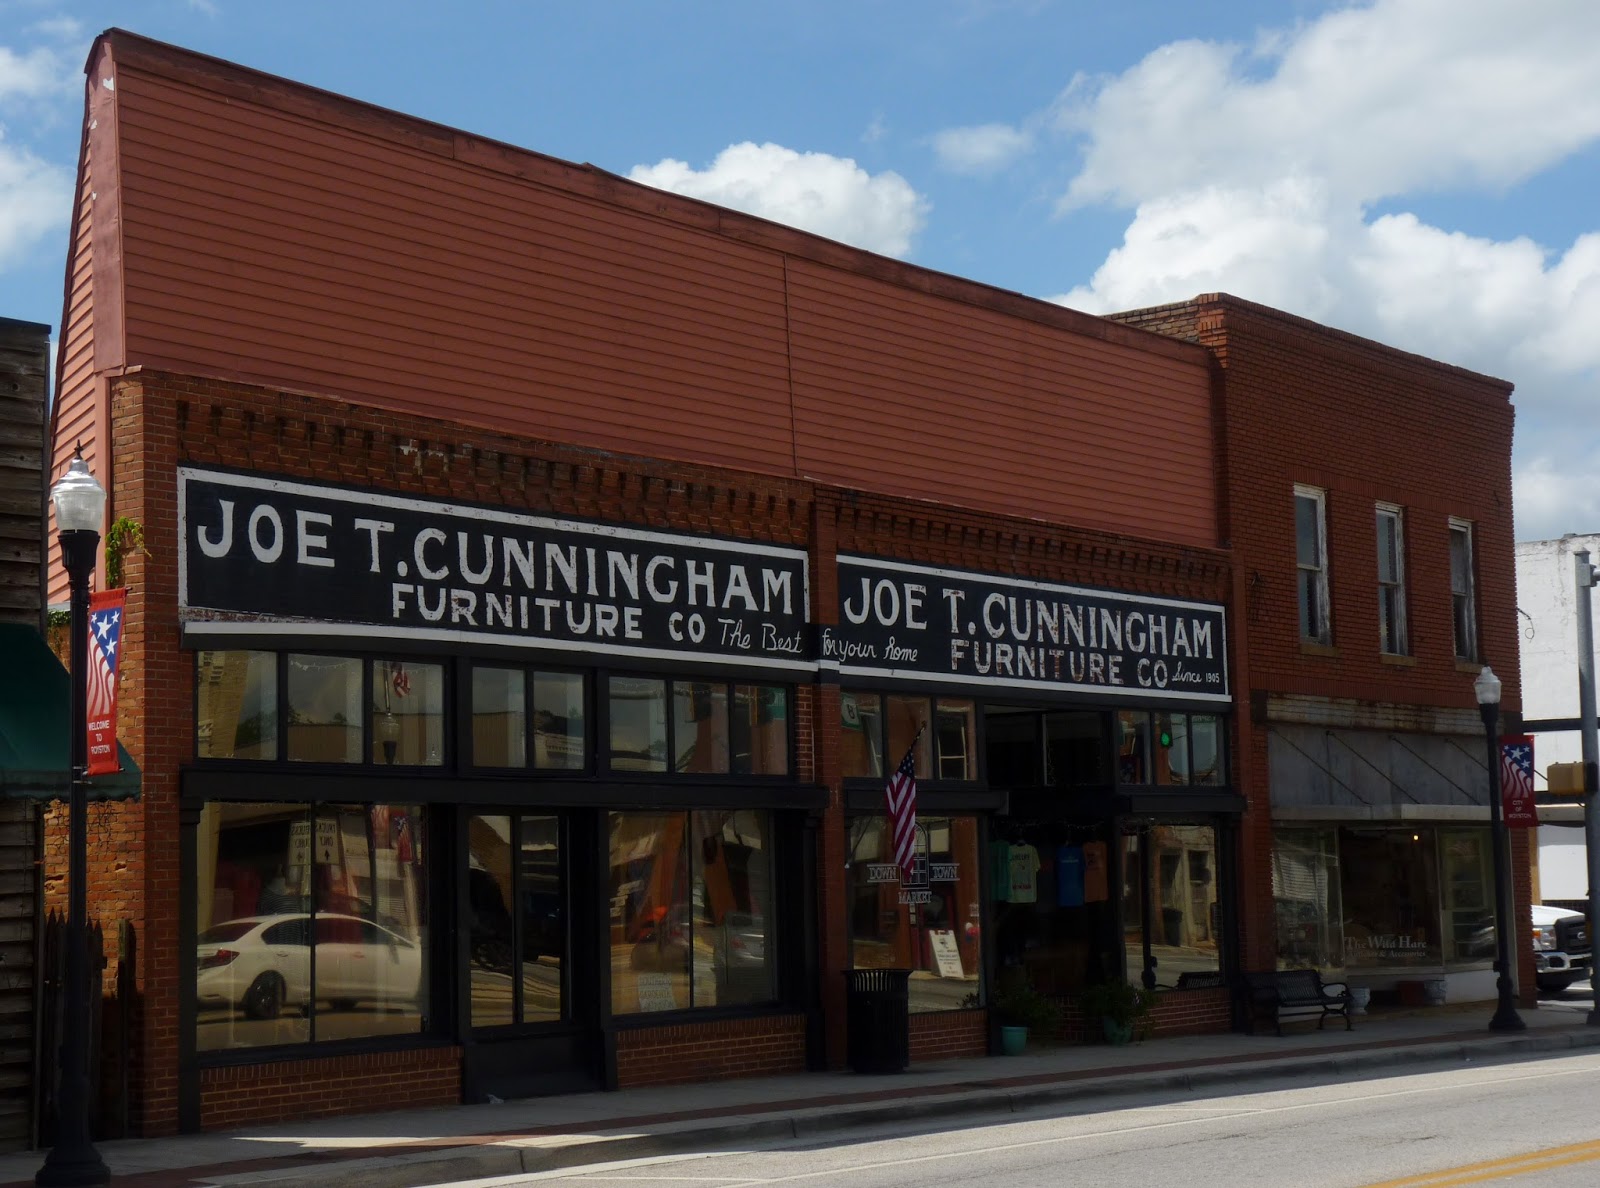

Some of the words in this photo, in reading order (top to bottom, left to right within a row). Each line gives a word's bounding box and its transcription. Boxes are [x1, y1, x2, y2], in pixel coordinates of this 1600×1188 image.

[197, 499, 336, 568] JOE
[843, 577, 927, 630] JOE
[392, 582, 643, 639] FURNITURE
[668, 611, 706, 643] CO
[718, 617, 751, 650] The
[762, 622, 803, 654] Best
[838, 640, 877, 662] your
[883, 636, 918, 662] home
[951, 639, 1124, 685] FURNITURE
[1137, 658, 1168, 688] CO
[88, 720, 110, 731] WELCOME
[95, 733, 103, 742] TO
[91, 745, 110, 754] ROYSTON
[869, 866, 897, 880] DOWN
[932, 865, 958, 879] TOWN
[898, 891, 932, 904] MARKET
[1367, 935, 1396, 949] Wild
[1398, 935, 1427, 949] Hare
